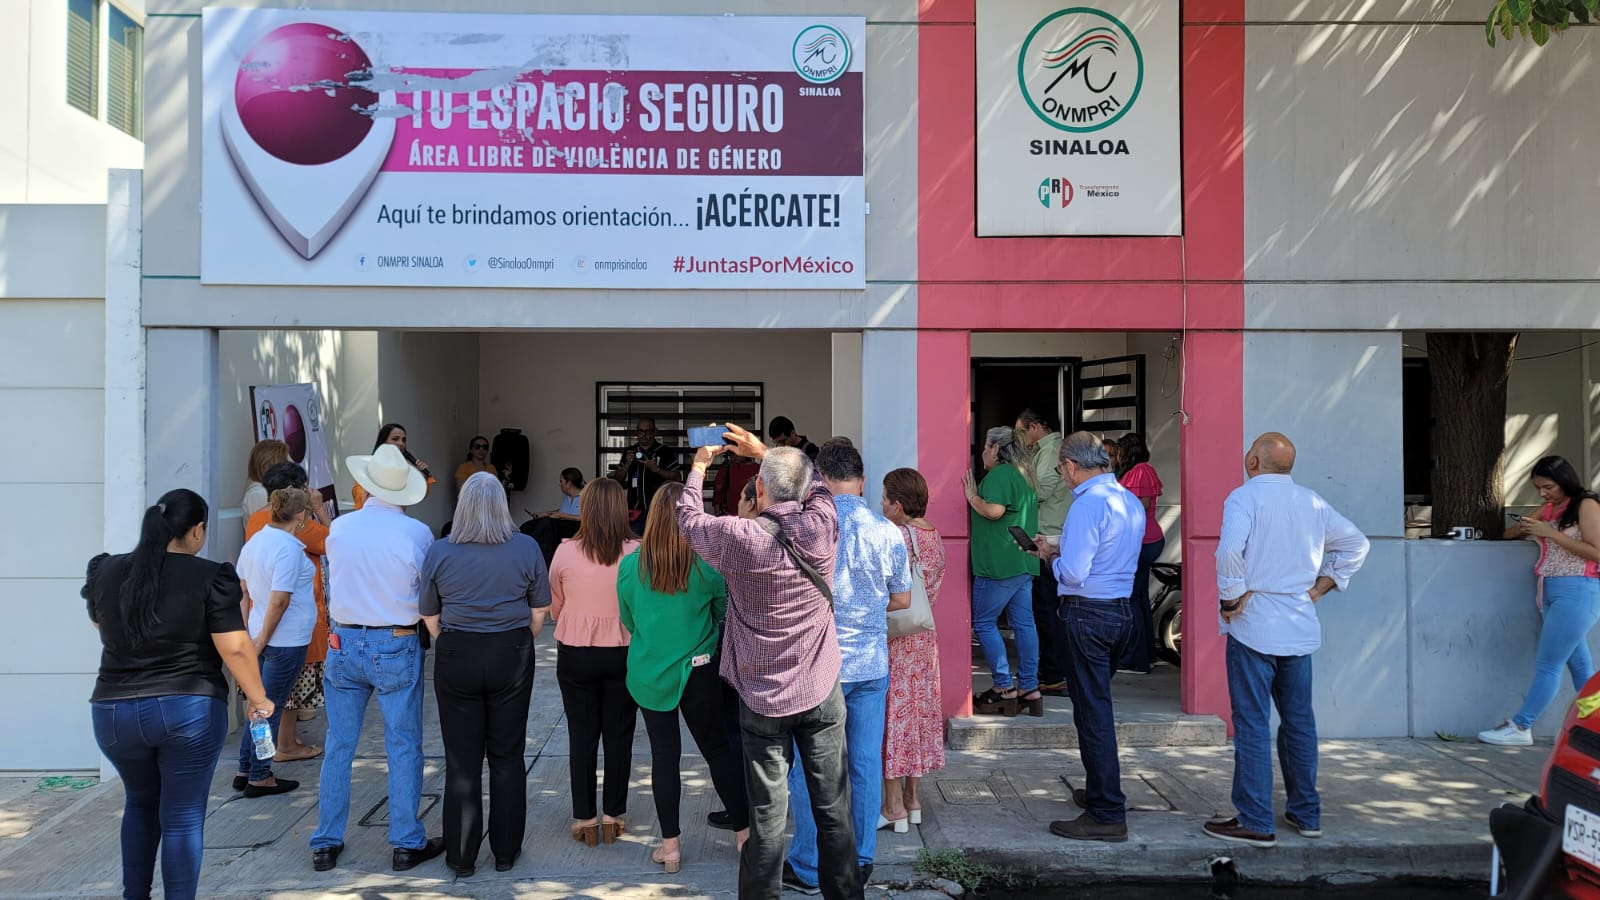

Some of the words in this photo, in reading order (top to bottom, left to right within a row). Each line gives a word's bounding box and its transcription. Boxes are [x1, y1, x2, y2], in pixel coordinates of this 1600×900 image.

[803, 65, 838, 78] ONMPRI
[799, 87, 842, 97] SINALOA
[467, 81, 625, 132] ESPACIO
[639, 82, 785, 134] SEGURO
[1042, 95, 1121, 123] ONMPRI
[408, 138, 460, 167] ÁREA
[467, 144, 524, 168] LIBRE
[532, 145, 557, 168] DE
[564, 146, 669, 170] VIOLENCIA
[676, 148, 701, 170] DE
[708, 144, 783, 170] GÉNERO
[1029, 139, 1130, 156] SINALOA
[1087, 189, 1120, 198] México
[377, 203, 422, 228] Aquí
[427, 206, 447, 225] te
[452, 204, 557, 227] brindamos
[562, 205, 690, 227] orientación...
[696, 187, 841, 231] ¡ACÉRCATE!
[377, 256, 410, 268] ONMPRI
[411, 256, 444, 269] SINALOA
[487, 256, 555, 272] @SinaloaOnmpri
[594, 259, 648, 272] onmprisinaloa
[673, 255, 854, 274] #JuntasPorMéxico
